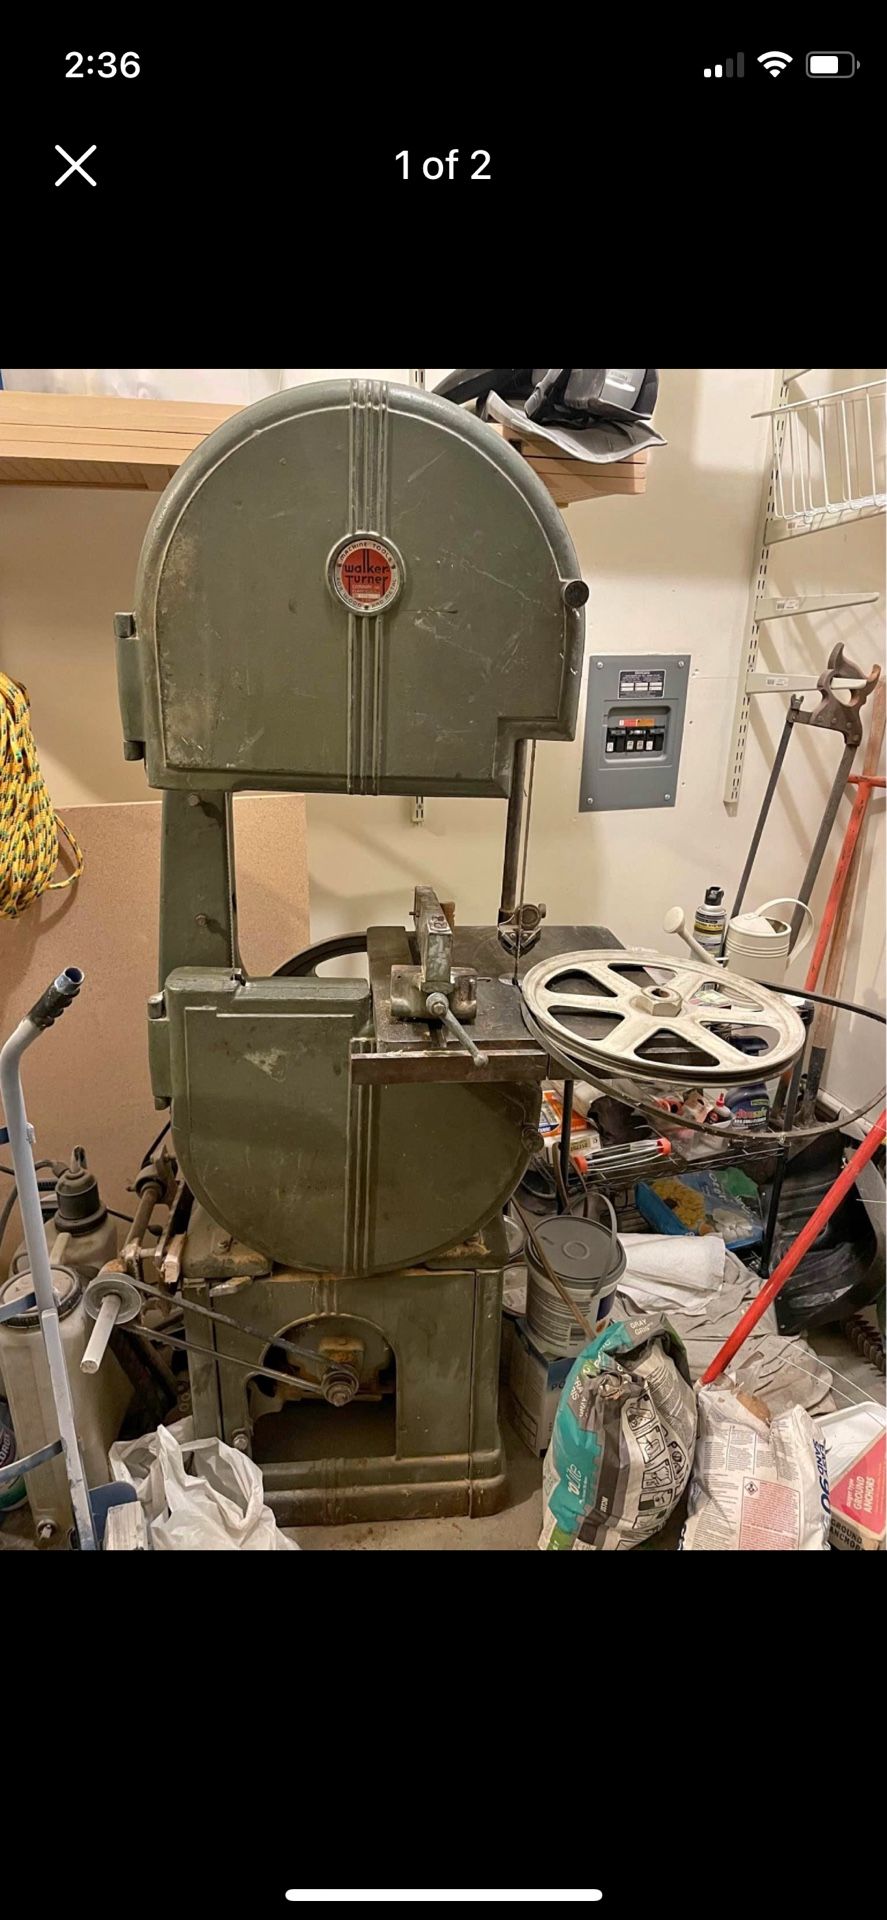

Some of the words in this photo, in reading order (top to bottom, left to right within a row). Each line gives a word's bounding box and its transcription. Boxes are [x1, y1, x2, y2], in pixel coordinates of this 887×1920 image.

[372, 543, 393, 562] TOOLS
[853, 1476, 865, 1511] GROUND
[829, 1525, 865, 1551] ANCHOR
[830, 1518, 863, 1544] GROUND
